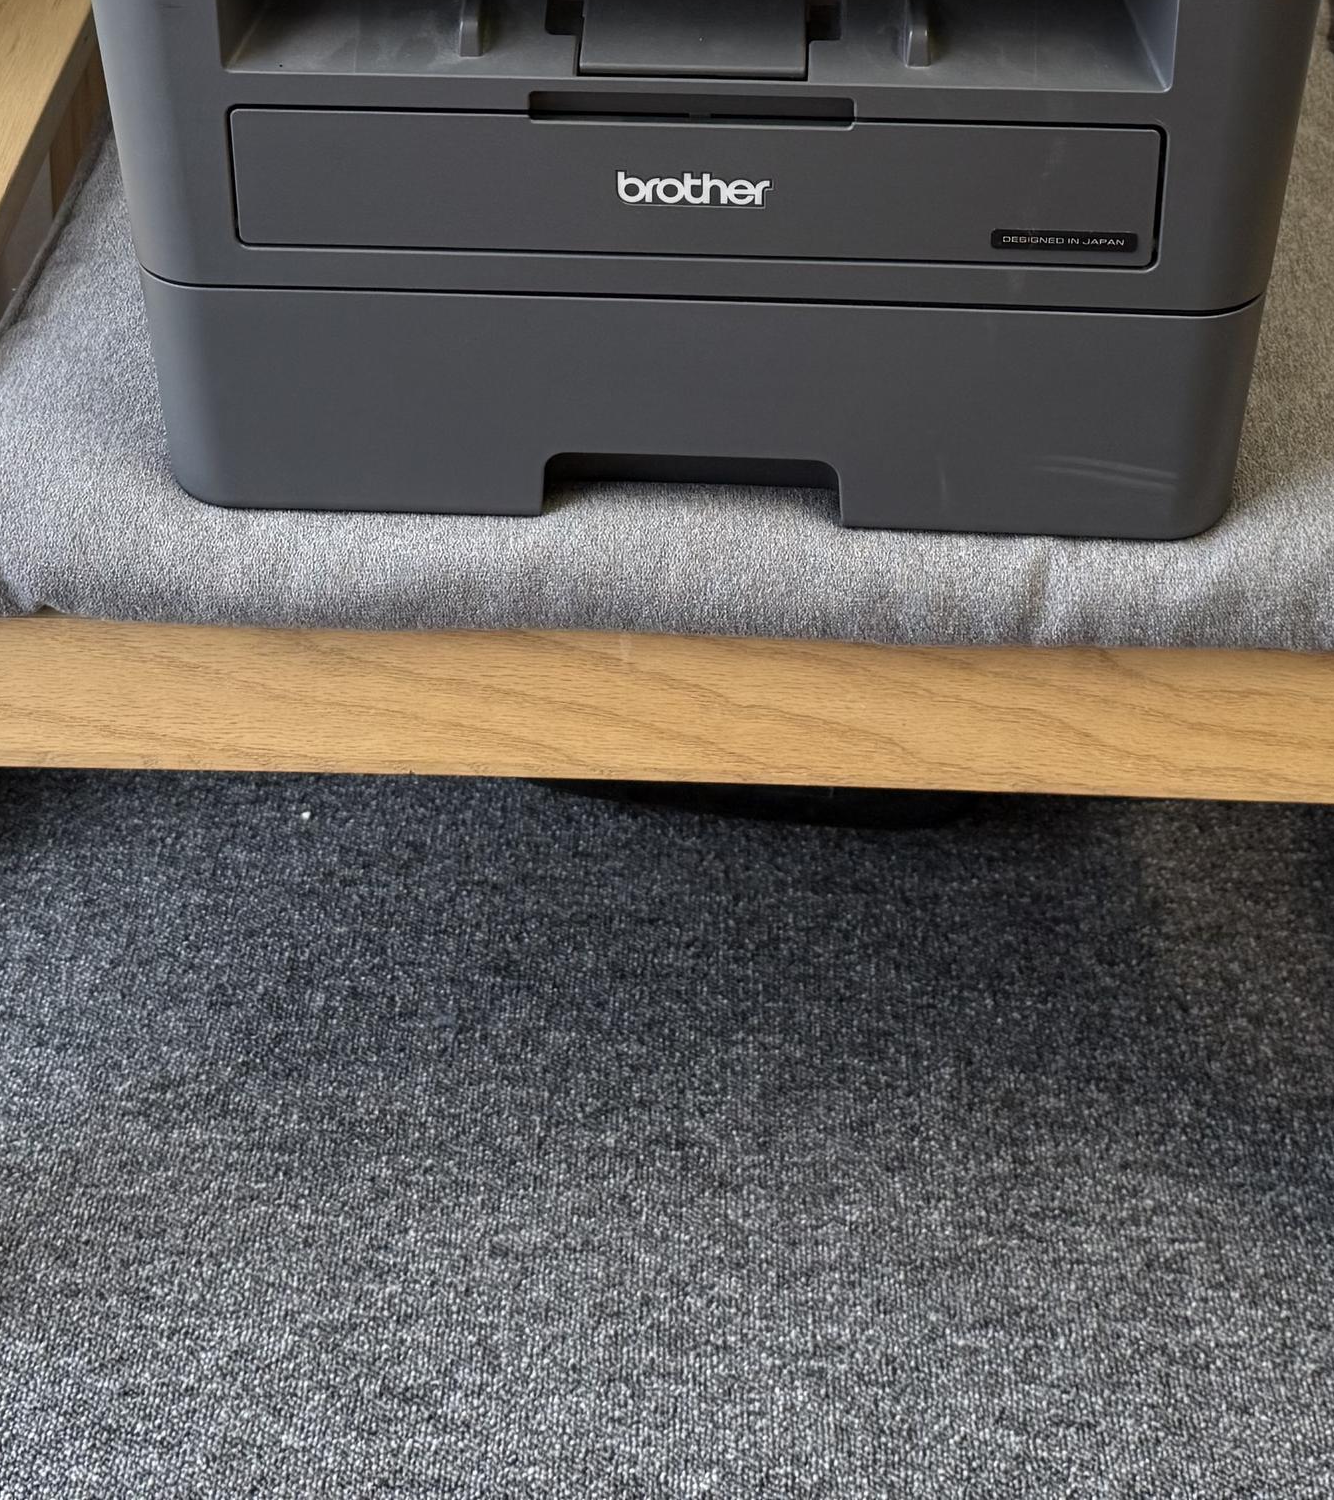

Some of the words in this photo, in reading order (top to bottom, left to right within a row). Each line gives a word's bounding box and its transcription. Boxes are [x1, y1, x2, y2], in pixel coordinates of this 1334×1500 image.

[616, 171, 772, 206] brother
[1002, 235, 1065, 245] DESIGNED
[1067, 237, 1080, 245] IN
[1082, 238, 1125, 247] JAPAN
